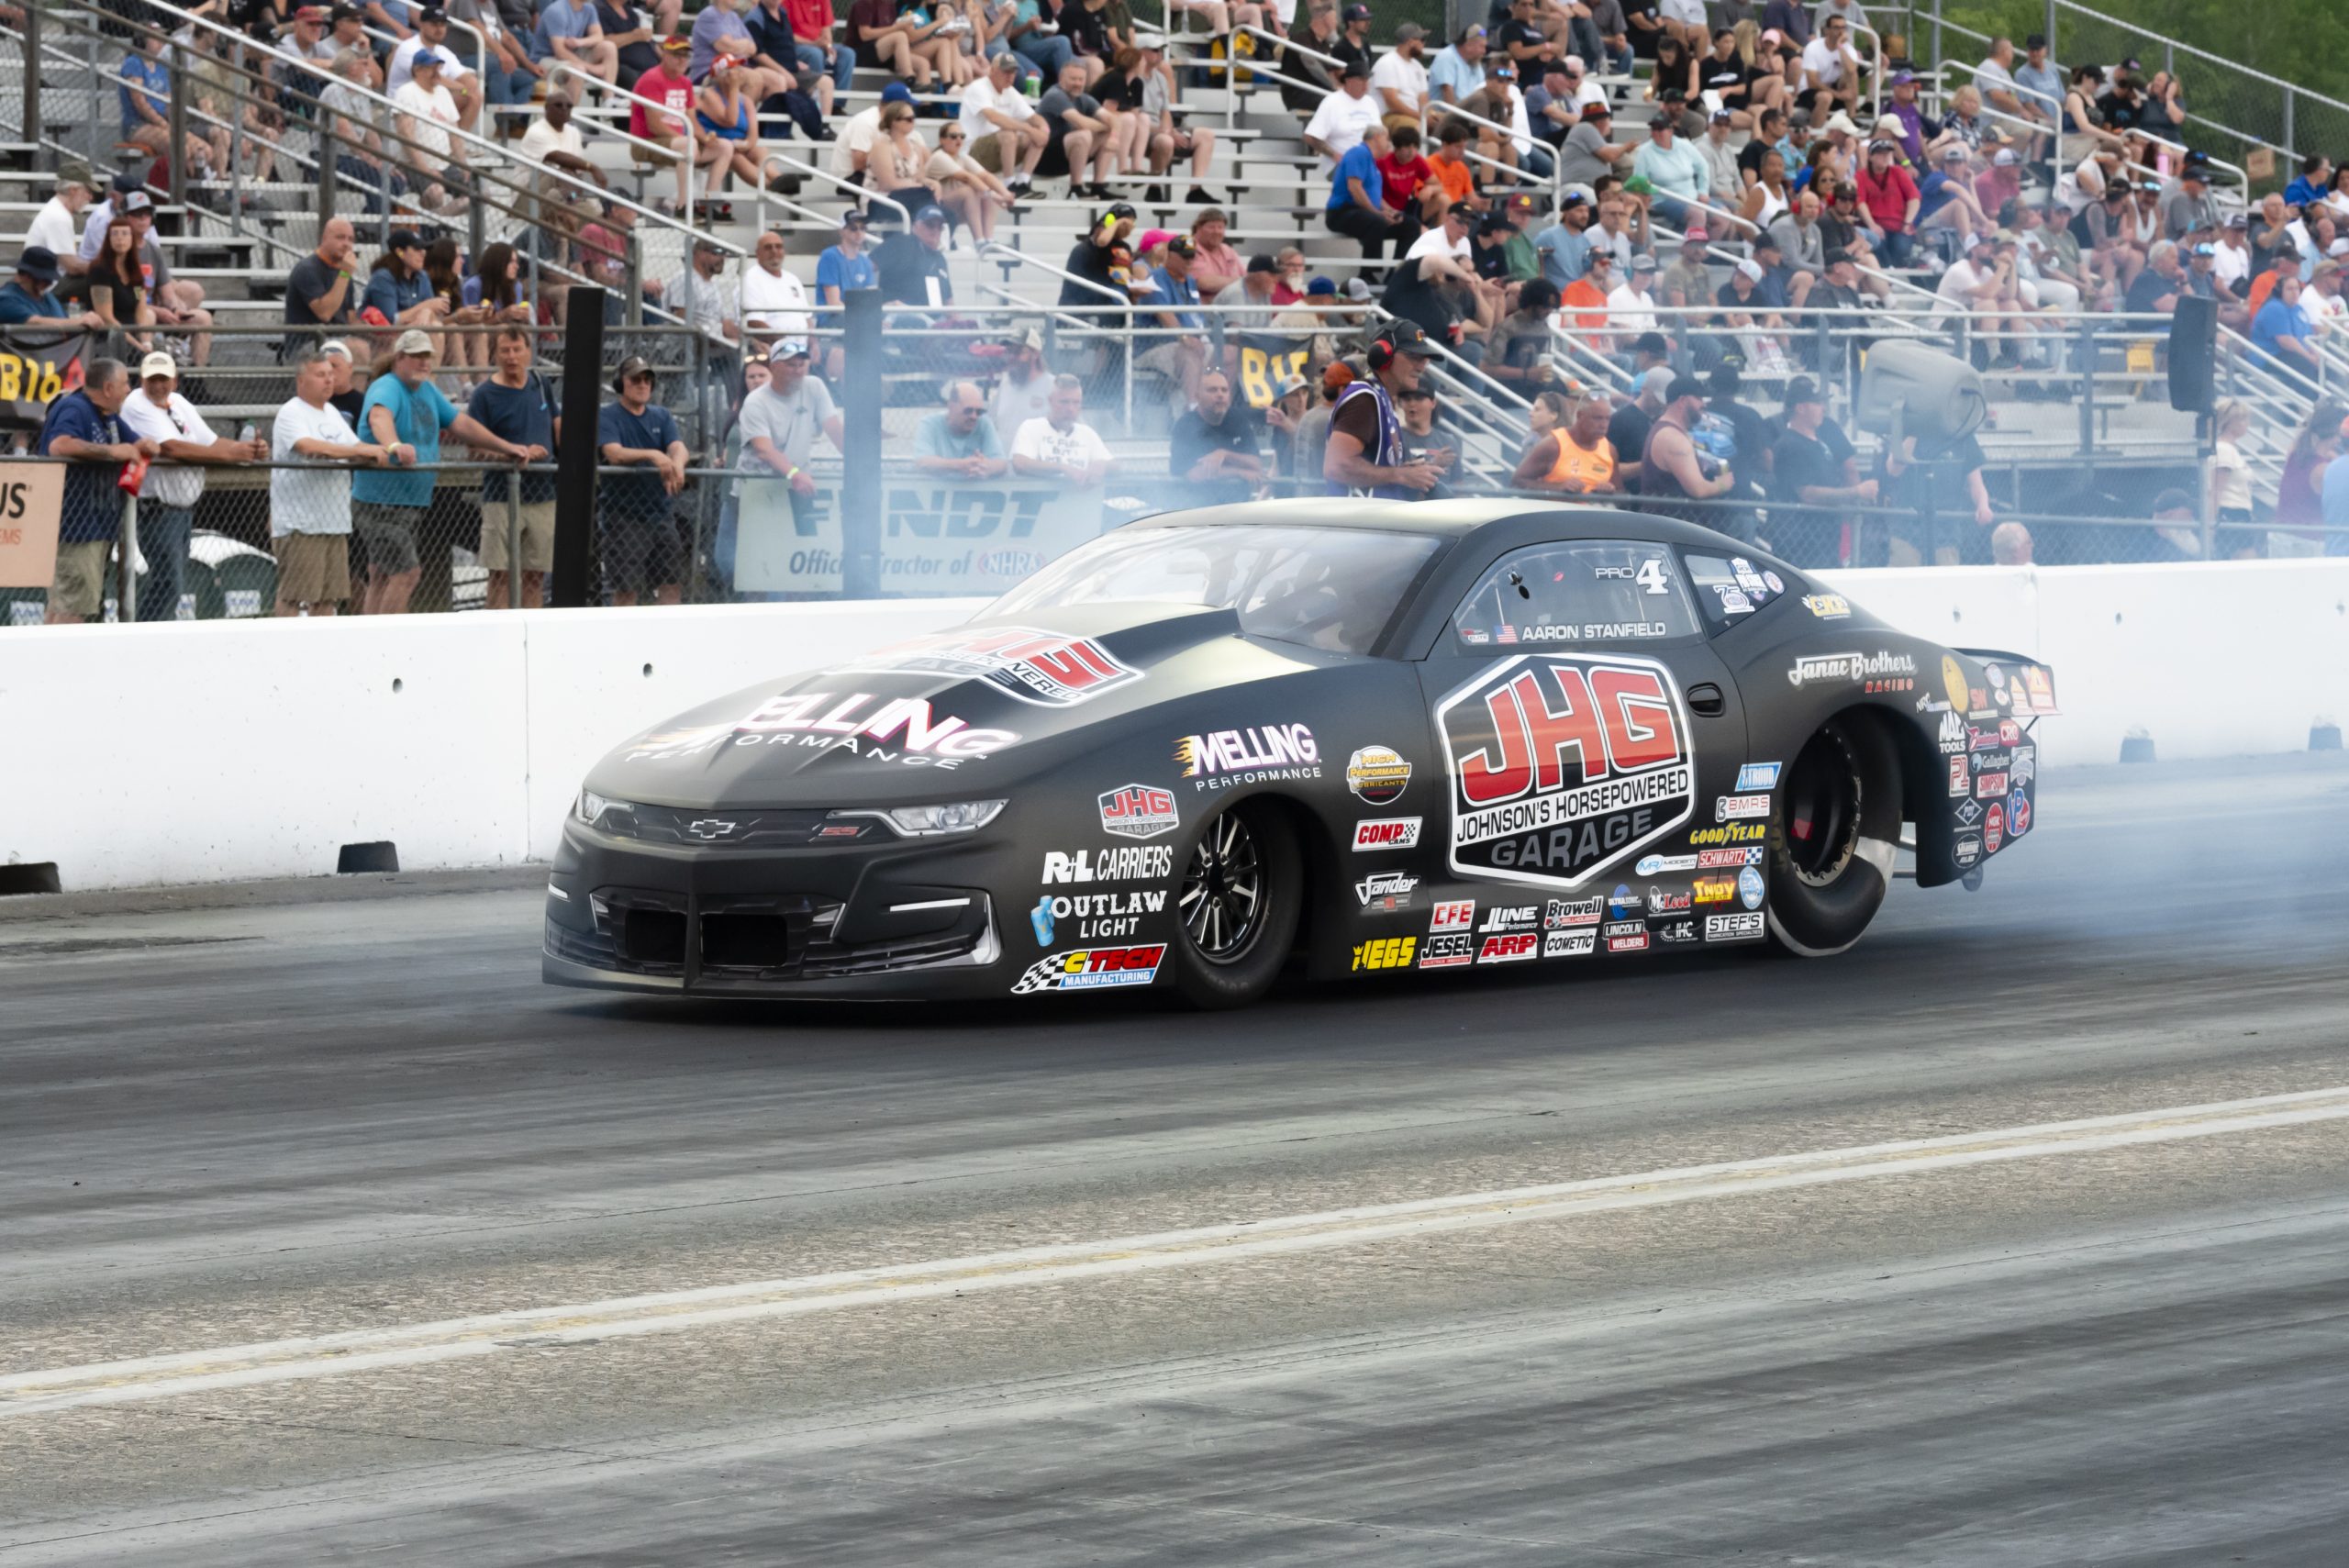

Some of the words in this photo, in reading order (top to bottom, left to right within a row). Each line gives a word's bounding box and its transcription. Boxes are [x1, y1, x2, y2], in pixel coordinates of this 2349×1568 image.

[788, 489, 1059, 538] FNDT
[789, 550, 844, 575] Offici
[880, 552, 949, 576] ractor
[950, 550, 972, 575] of
[987, 551, 1039, 576] NHRA
[1595, 566, 1635, 580] PRO
[1636, 559, 1669, 595] 4
[1521, 625, 1580, 641] AARON
[1584, 622, 1667, 640] STANFIELD
[1850, 651, 1916, 680] Brothers
[1458, 665, 1680, 807] JHG
[1939, 740, 1966, 753] TOOLS
[1192, 723, 1319, 776] MELLING
[1362, 754, 1397, 764] HIGH
[1350, 766, 1409, 777] PERFORMANCE
[1982, 753, 2010, 770] Gallagher
[1195, 766, 1322, 792] PERFORMANCE
[1742, 766, 1775, 788] STROUD
[1978, 773, 2006, 792] SIMPSON
[1104, 789, 1174, 817] JHG
[1456, 799, 1551, 842] JOHNSON'S
[1555, 769, 1688, 820] HORSEPOWERED
[1728, 796, 1769, 811] BMRS
[1117, 823, 1166, 835] GARAGE
[1358, 824, 1405, 844] COMP
[1490, 808, 1653, 868] GARAGE
[1388, 838, 1411, 846] CAMS
[1097, 845, 1173, 882] CARRIERS
[1699, 849, 1745, 866] SCHWARTZ
[1355, 872, 1419, 906] Sander
[1051, 890, 1167, 918] OUTLAW
[1548, 897, 1602, 917] Browell
[1651, 892, 1691, 910] McLeod
[1433, 904, 1473, 926] CFE
[1709, 914, 1761, 932] STEF'S
[1079, 917, 1140, 939] LIGHT
[1605, 922, 1642, 937] LINCOLN
[1421, 933, 1473, 959] JESEL
[1480, 934, 1538, 958] ARP
[1546, 935, 1594, 951] COMETIC
[1612, 937, 1644, 950] WELDERS
[1352, 936, 1418, 972] JEGS
[1065, 970, 1152, 986] MANUFACTURING
